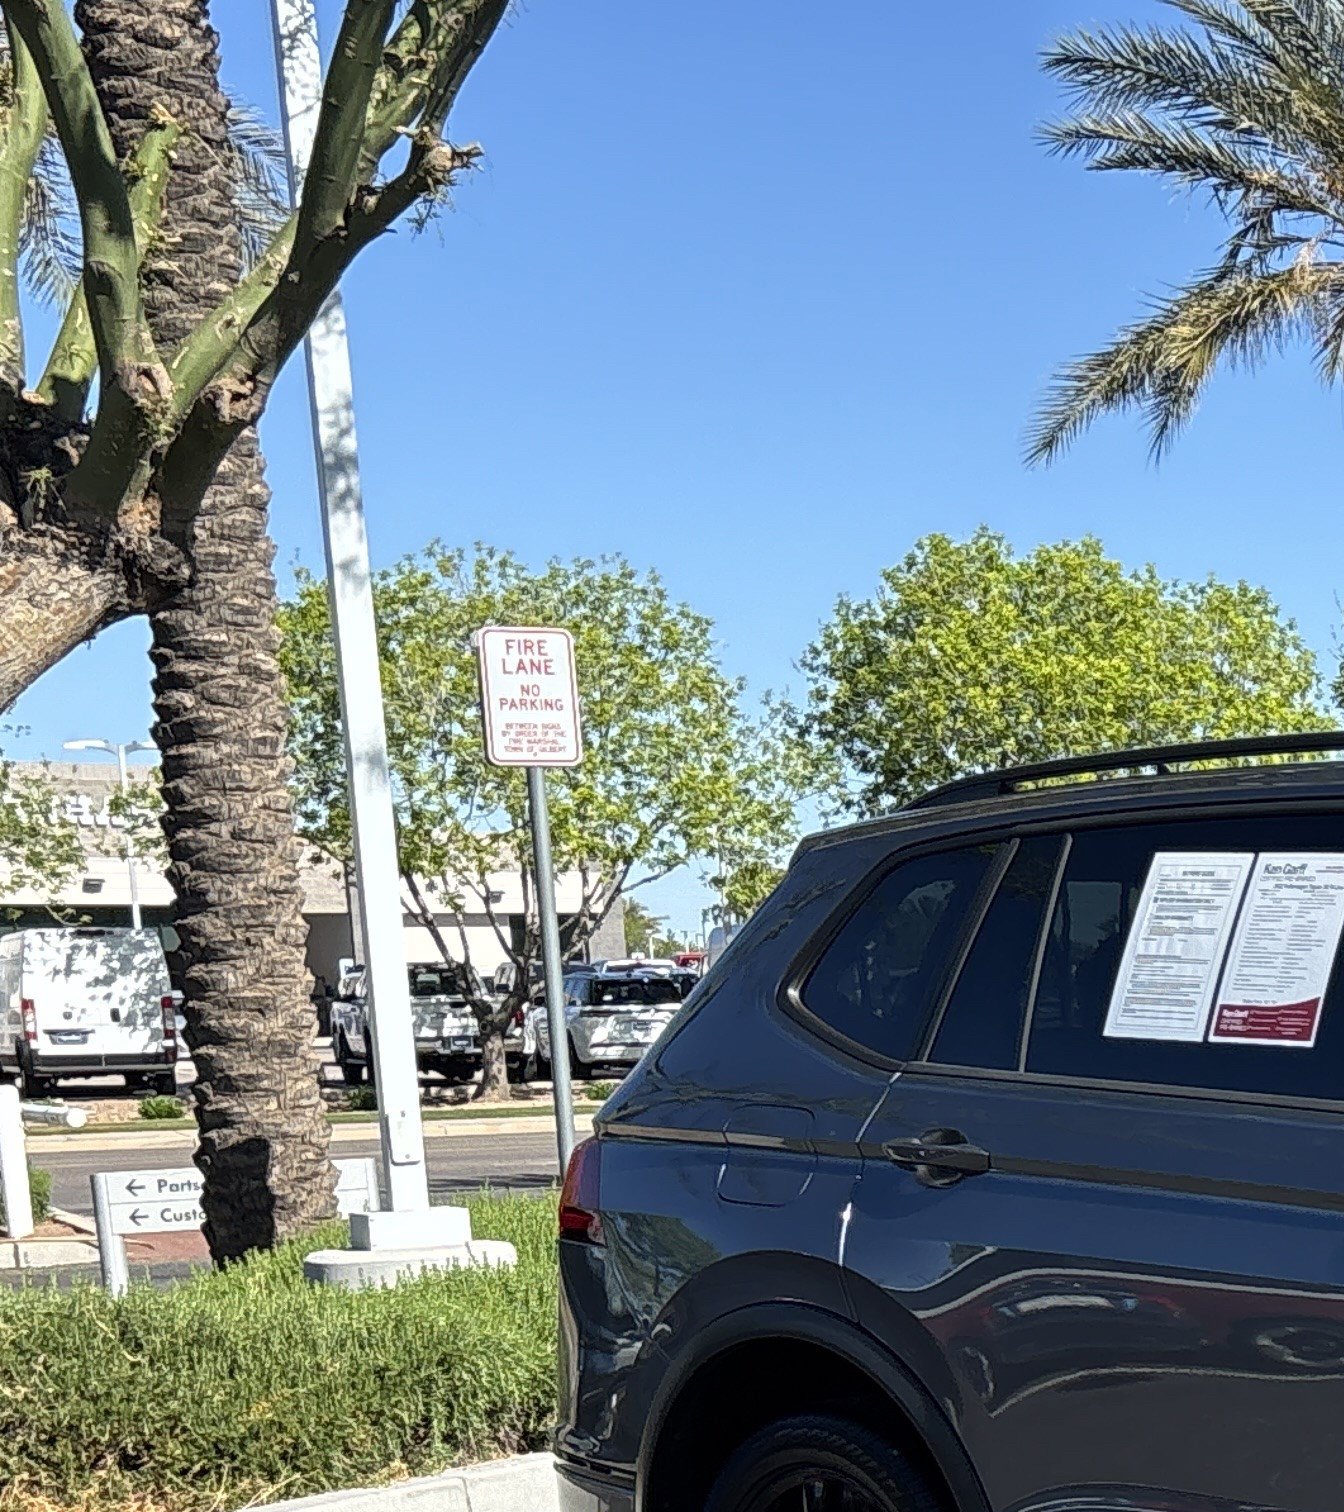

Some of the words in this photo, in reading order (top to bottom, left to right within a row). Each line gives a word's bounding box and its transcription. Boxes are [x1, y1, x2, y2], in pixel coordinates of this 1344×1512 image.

[505, 639, 548, 656] FIRE
[502, 658, 555, 675] LANE
[520, 684, 540, 697] NO
[499, 698, 564, 711] PARKING
[156, 1178, 201, 1194] Parts
[160, 1207, 208, 1222] Custo
